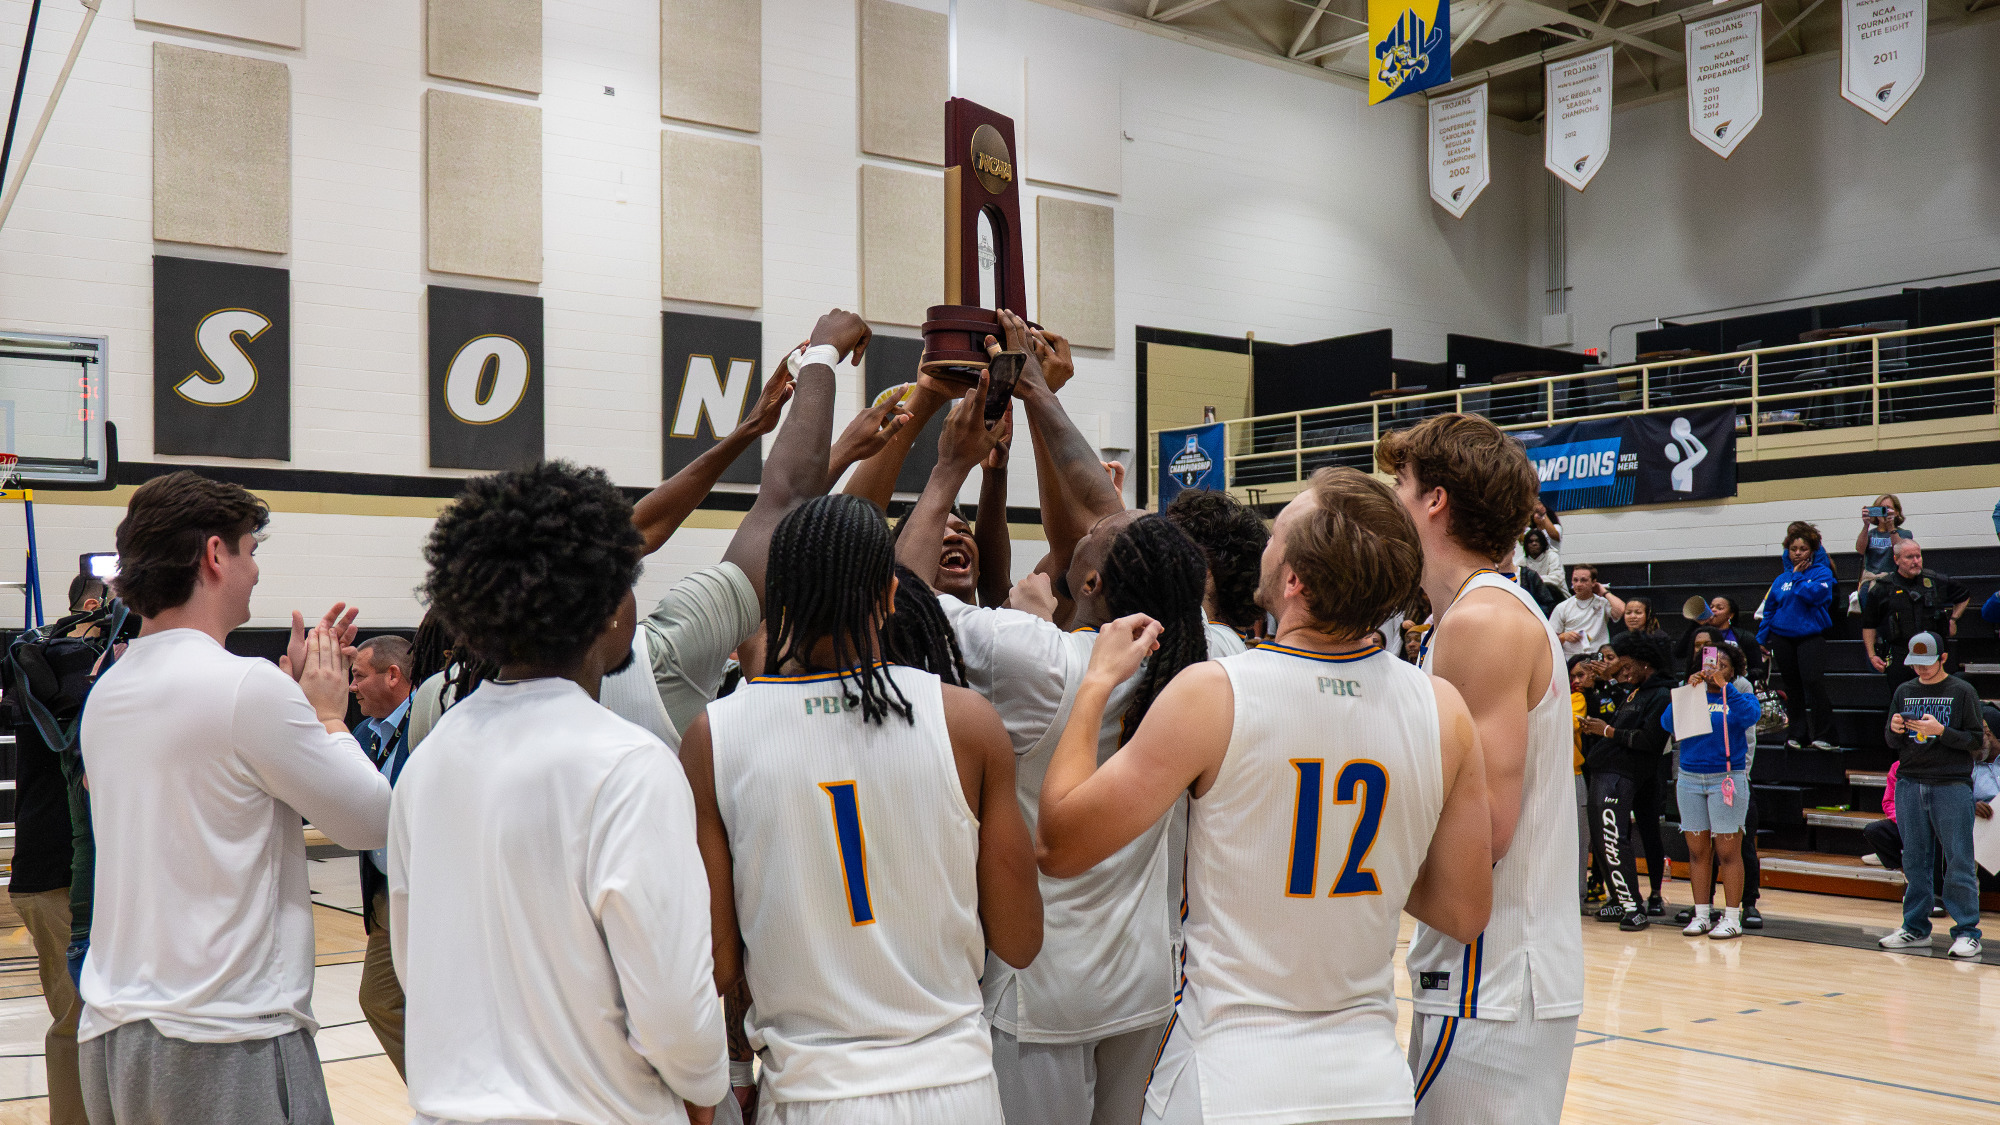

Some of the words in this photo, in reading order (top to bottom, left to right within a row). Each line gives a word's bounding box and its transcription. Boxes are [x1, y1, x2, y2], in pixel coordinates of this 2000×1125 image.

[1872, 6, 1896, 18] NCAA
[1857, 10, 1914, 32] TOURNAMENT
[1704, 21, 1743, 38] TROJANS
[1861, 28, 1882, 40] ELITE
[1884, 22, 1910, 34] EIGHT
[1700, 42, 1716, 50] MEN'S
[1716, 34, 1748, 47] BASKETBALL
[1714, 50, 1735, 60] NCAA
[1874, 50, 1898, 65] 2011
[1564, 62, 1597, 78] TROJANS
[1699, 54, 1750, 73] TOURNAMENT
[1697, 62, 1750, 82] APPEARANCES
[1558, 94, 1570, 104] SAC
[1571, 86, 1602, 100] REGULAR
[1704, 86, 1720, 95] 2010
[1442, 97, 1472, 111] TROJANS
[1566, 98, 1592, 110] SEASON
[1704, 95, 1719, 103] 2011
[1562, 104, 1600, 120] CHAMPIONS
[1704, 102, 1720, 111] 2012
[1704, 110, 1719, 119] 2014
[1439, 120, 1476, 134] CONFERENCE
[1442, 128, 1474, 142] CAROLINAS
[1564, 130, 1577, 139] 2012
[1445, 137, 1472, 149] REGULAR
[1448, 146, 1470, 157] SEASON
[1442, 152, 1476, 166] CHAMPIONS
[978, 151, 1012, 182] NCAA
[1449, 166, 1470, 178] 2002
[173, 307, 273, 406] S
[443, 333, 531, 425] O
[670, 353, 756, 440] N
[1620, 453, 1637, 462] WIN
[1170, 460, 1211, 474] CHAMPIONSHIP
[1618, 461, 1638, 471] HERE
[1318, 676, 1362, 698] PBC
[1285, 758, 1390, 898] 12
[1602, 808, 1620, 866] CHILD
[818, 780, 876, 926] 1
[1611, 870, 1638, 912] WILD
